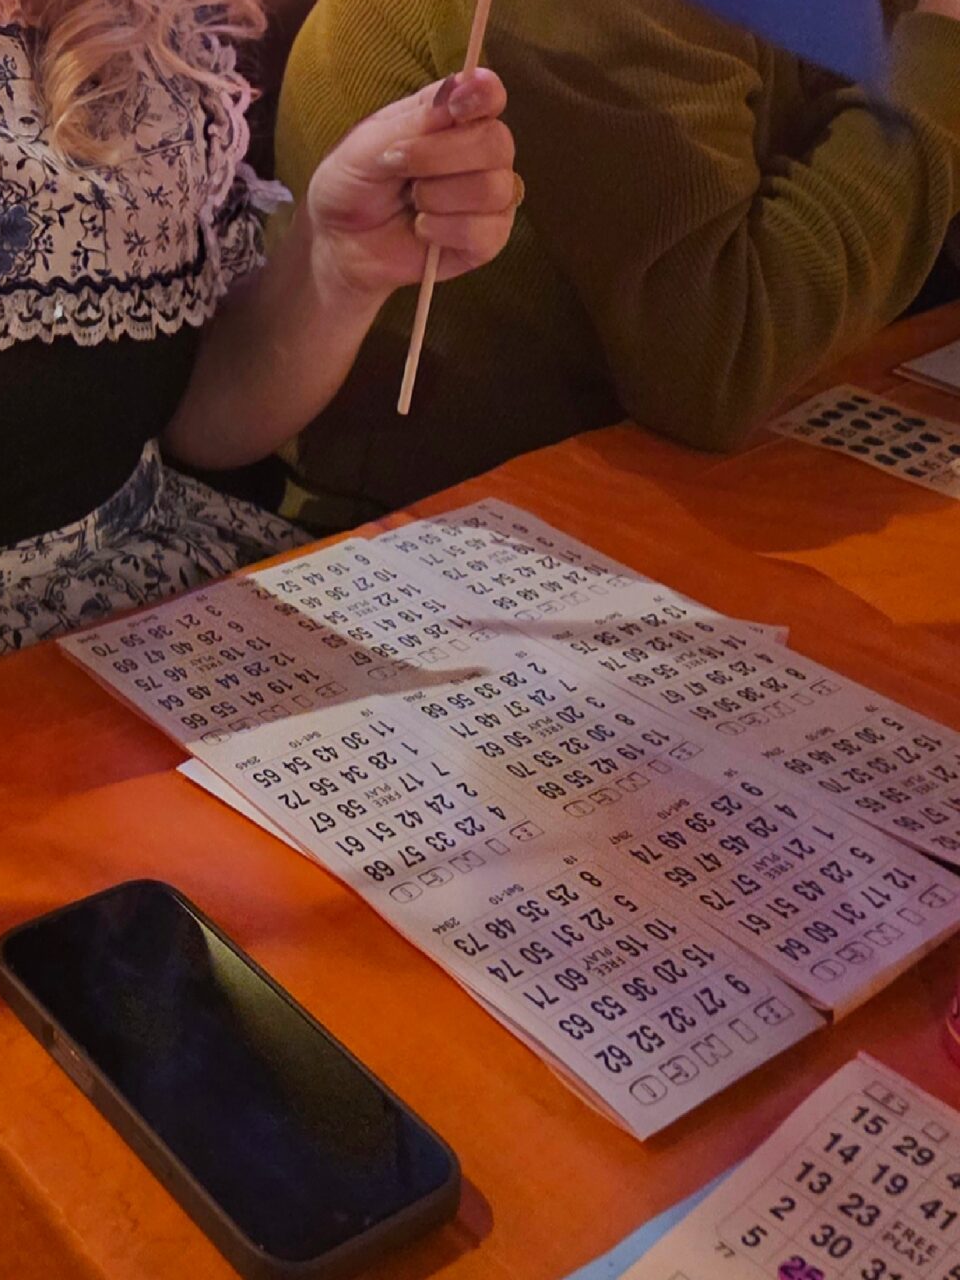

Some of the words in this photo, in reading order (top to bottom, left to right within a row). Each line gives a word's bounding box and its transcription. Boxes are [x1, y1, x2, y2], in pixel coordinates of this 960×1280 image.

[243, 662, 270, 676] 29
[269, 653, 295, 666] 12
[528, 662, 546, 674] 2
[215, 674, 240, 689] 44
[294, 669, 319, 684] 14
[500, 672, 526, 687] 28
[559, 680, 577, 692] 7
[187, 686, 211, 699] 49
[268, 680, 292, 694] 19
[474, 683, 501, 698] 33
[158, 695, 184, 710] 64
[240, 692, 264, 706] 41
[528, 689, 555, 706] 24
[586, 697, 605, 708] 3
[210, 702, 238, 718] 55
[421, 704, 448, 718] 68
[504, 701, 530, 718] 37
[556, 706, 584, 723] 20
[181, 714, 208, 729] 66
[369, 721, 394, 737] 11
[475, 714, 500, 728] 48
[526, 716, 553, 732] PLAY
[615, 714, 635, 725] 8
[288, 730, 322, 749] Set-10
[450, 722, 478, 738] 71
[504, 732, 532, 747] 50
[537, 723, 564, 738] FREE
[586, 725, 615, 741] 30
[642, 730, 670, 746] 13
[342, 732, 369, 749] 30
[401, 742, 418, 755] 1
[476, 742, 505, 757] 62
[559, 738, 589, 754] 32
[312, 746, 338, 762] 43
[368, 752, 397, 769] 28
[533, 751, 562, 767] 53
[617, 744, 644, 760] 19
[283, 757, 312, 775] 54
[340, 766, 368, 784] 34
[432, 762, 450, 776] 7
[506, 762, 536, 778] 70
[589, 758, 618, 774] 42
[253, 769, 281, 788] 65
[309, 778, 339, 796] 56
[399, 773, 424, 792] 17
[563, 770, 594, 788] 55
[363, 782, 391, 800] PLAY
[456, 783, 478, 796] 2
[537, 782, 566, 799] 69
[741, 782, 763, 796] 9
[278, 790, 310, 809] 72
[374, 790, 402, 808] FREE
[425, 794, 454, 814] 24
[711, 795, 742, 816] 25
[337, 800, 366, 818] 58
[487, 806, 506, 820] 4
[774, 805, 797, 819] 4
[310, 812, 336, 833] 67
[394, 810, 423, 828] 42
[454, 816, 485, 836] 23
[685, 812, 716, 832] 39
[746, 816, 778, 838] 29
[366, 822, 396, 842] 51
[658, 832, 686, 849] 49
[812, 826, 834, 840] 1
[336, 836, 365, 856] 61
[425, 832, 456, 852] 33
[719, 836, 749, 855] 45
[783, 838, 815, 860] 21
[398, 846, 426, 868] 57
[629, 844, 662, 864] 74
[694, 853, 722, 872] 47
[751, 850, 778, 871] PLAY
[850, 847, 875, 864] 5
[364, 861, 394, 881] 68
[580, 872, 602, 887] 8
[664, 867, 697, 888] 65
[764, 860, 794, 880] FREE
[820, 861, 853, 883] 23
[883, 868, 916, 888] 12
[488, 883, 524, 905] Set-10
[731, 874, 761, 896] 57
[793, 881, 825, 901] 43
[546, 884, 579, 906] 25
[614, 895, 638, 912] 5
[700, 890, 735, 910] 73
[861, 886, 891, 908] 17
[516, 900, 549, 922] 35
[766, 898, 800, 918] 51
[832, 903, 866, 925] 31
[485, 918, 516, 938] 48
[579, 908, 614, 930] 22
[738, 914, 771, 935] 61
[552, 925, 584, 947] 31
[644, 919, 676, 940] 10
[803, 921, 838, 943] 60
[454, 933, 488, 956] 73
[520, 942, 554, 964] 50
[616, 935, 648, 956] 16
[776, 938, 810, 961] 64
[580, 946, 613, 970] PLAY
[593, 954, 625, 976] FREE
[682, 944, 714, 968] 15
[488, 960, 523, 982] 74
[555, 968, 588, 991] 60
[653, 959, 687, 984] 20
[622, 977, 657, 1001] 36
[725, 974, 750, 994] 9
[524, 985, 559, 1009] 71
[694, 988, 726, 1016] 27
[591, 996, 627, 1020] 53
[559, 1014, 594, 1040] 63
[660, 1006, 696, 1033] 32
[627, 1025, 665, 1053] 52
[594, 1045, 632, 1073] 62
[851, 1105, 889, 1136] 15
[893, 1136, 935, 1166] 29
[824, 1132, 862, 1165] 14
[871, 1164, 908, 1196] 19
[920, 1198, 957, 1231] 41
[795, 1161, 833, 1195] 13
[838, 1193, 881, 1228] 23
[741, 1225, 768, 1248] 5
[770, 1196, 795, 1221] 2
[810, 1224, 852, 1259] 30
[892, 1221, 939, 1257] FREE
[881, 1231, 930, 1267] PLAY
